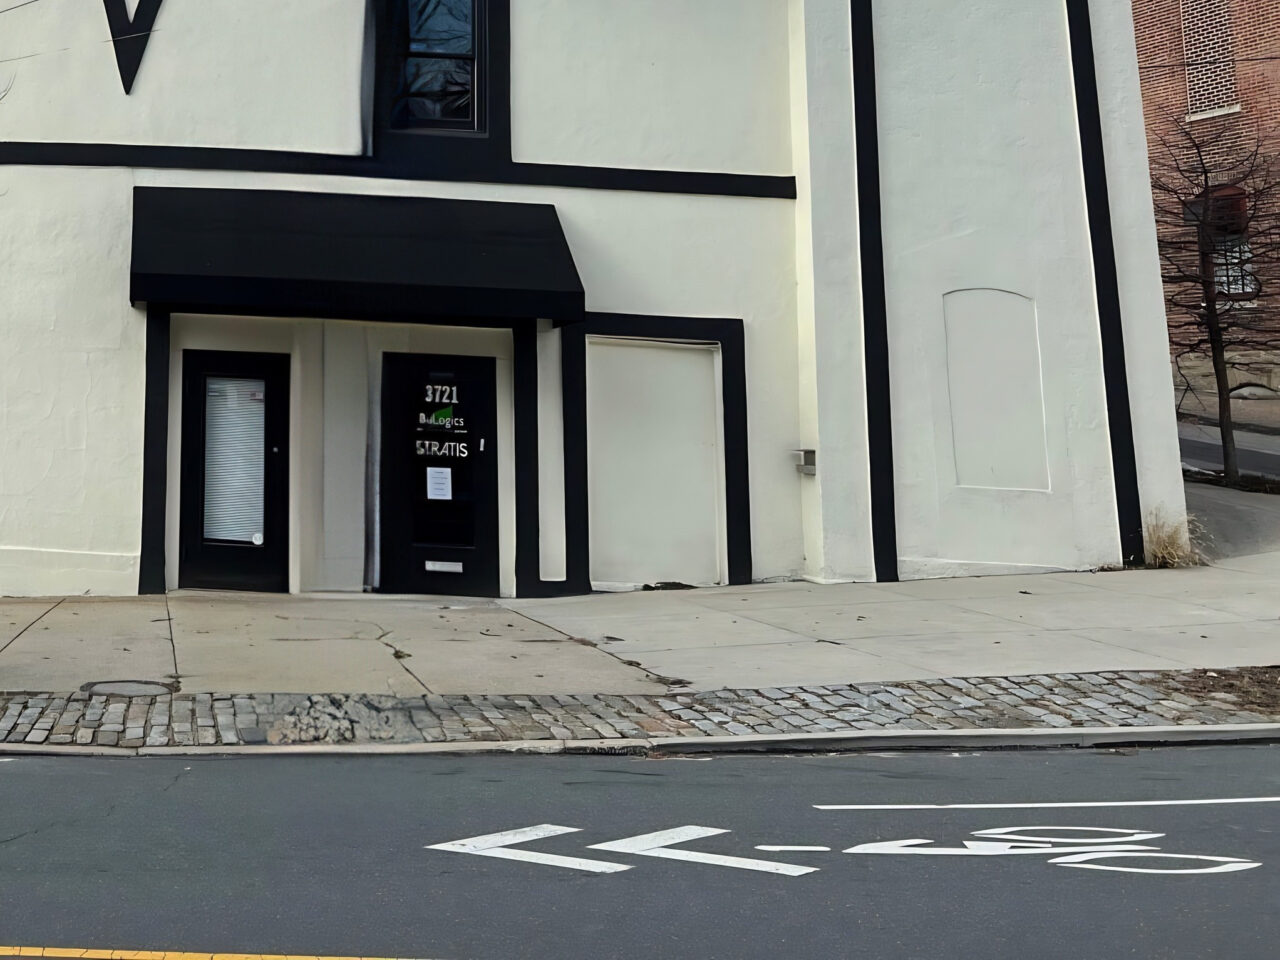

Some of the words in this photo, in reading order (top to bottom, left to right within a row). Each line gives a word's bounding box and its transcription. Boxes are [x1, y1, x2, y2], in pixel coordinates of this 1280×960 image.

[425, 385, 459, 403] 3721
[419, 413, 464, 428] BuLogics
[416, 440, 468, 457] STRATIS
